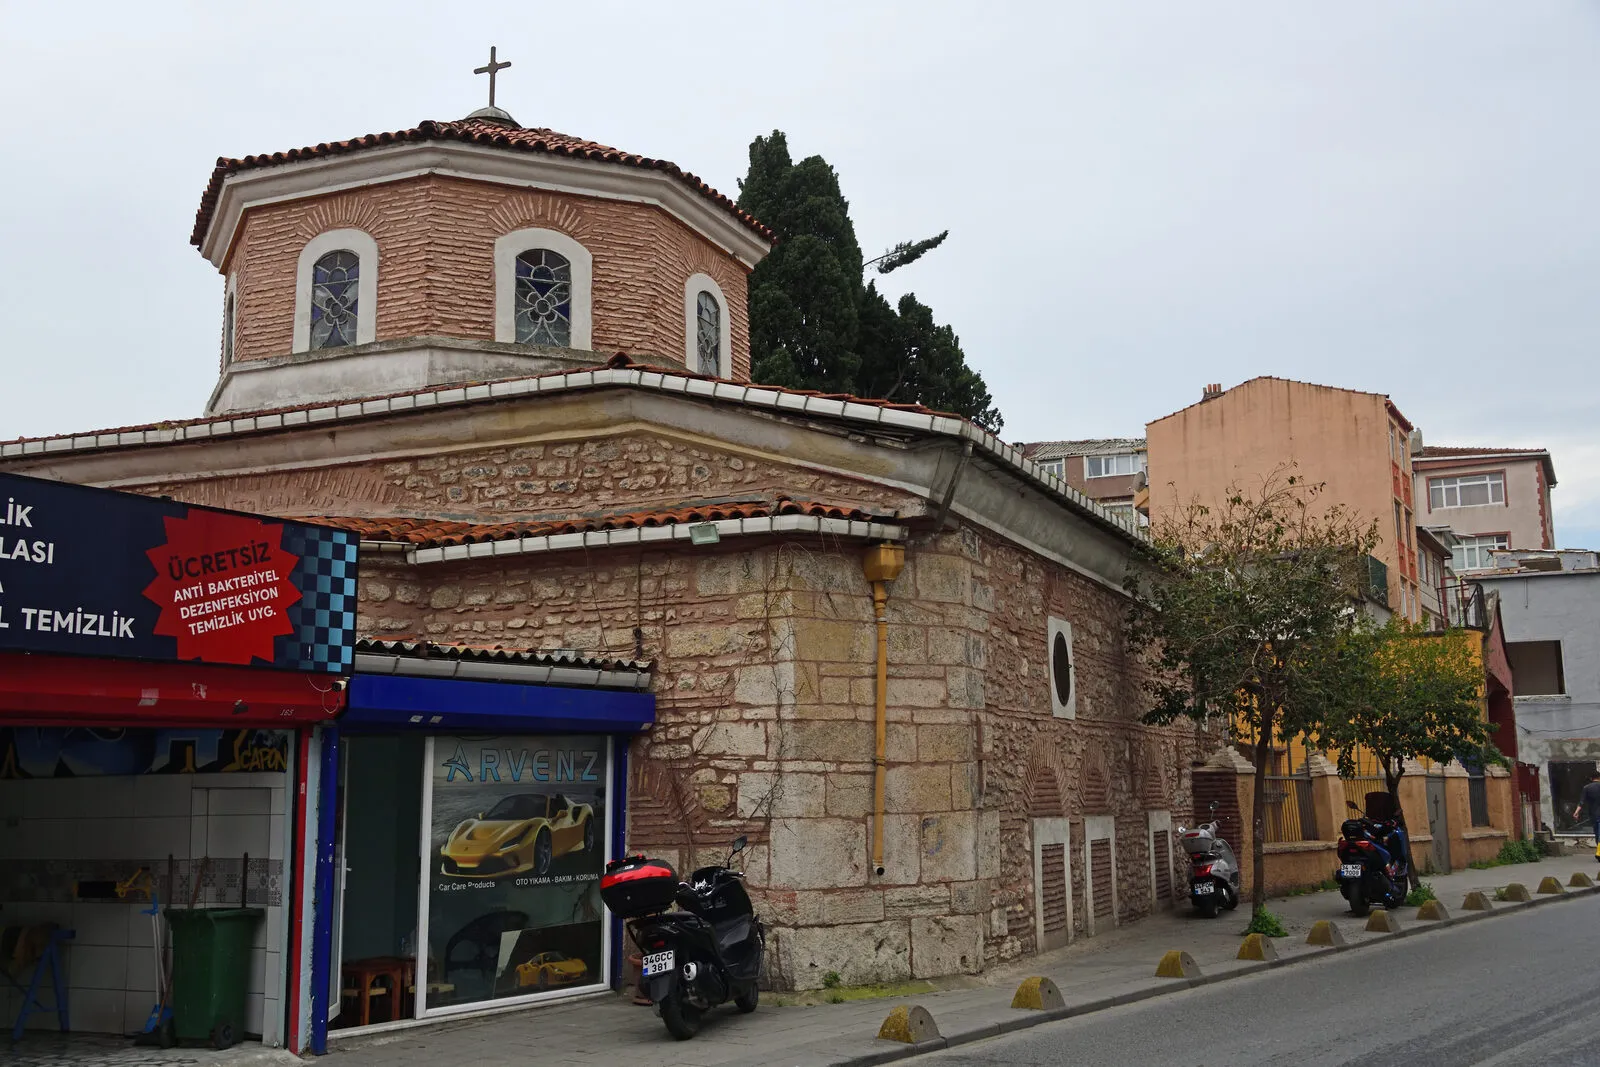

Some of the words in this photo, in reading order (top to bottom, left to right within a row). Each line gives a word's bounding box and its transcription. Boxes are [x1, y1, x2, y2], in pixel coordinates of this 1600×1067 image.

[168, 540, 271, 581] ÜCRETSİZ
[174, 582, 204, 603] ANTİ
[208, 570, 280, 595] BAKTERİYEL
[180, 587, 279, 619] DEZENFEKSİYON
[21, 607, 135, 638] TEMİZLİK
[188, 611, 245, 635] TEMİZLİK
[249, 606, 277, 621] UYG.
[442, 742, 599, 782] ARVENZ
[438, 883, 451, 891] Car
[451, 882, 467, 891] Care
[515, 878, 528, 886] OTO
[528, 876, 551, 885] YIKAMA
[554, 875, 572, 883] BAKIM
[576, 873, 599, 882] KORUMA
[643, 951, 673, 966] 34GCC
[652, 962, 667, 973] 381
